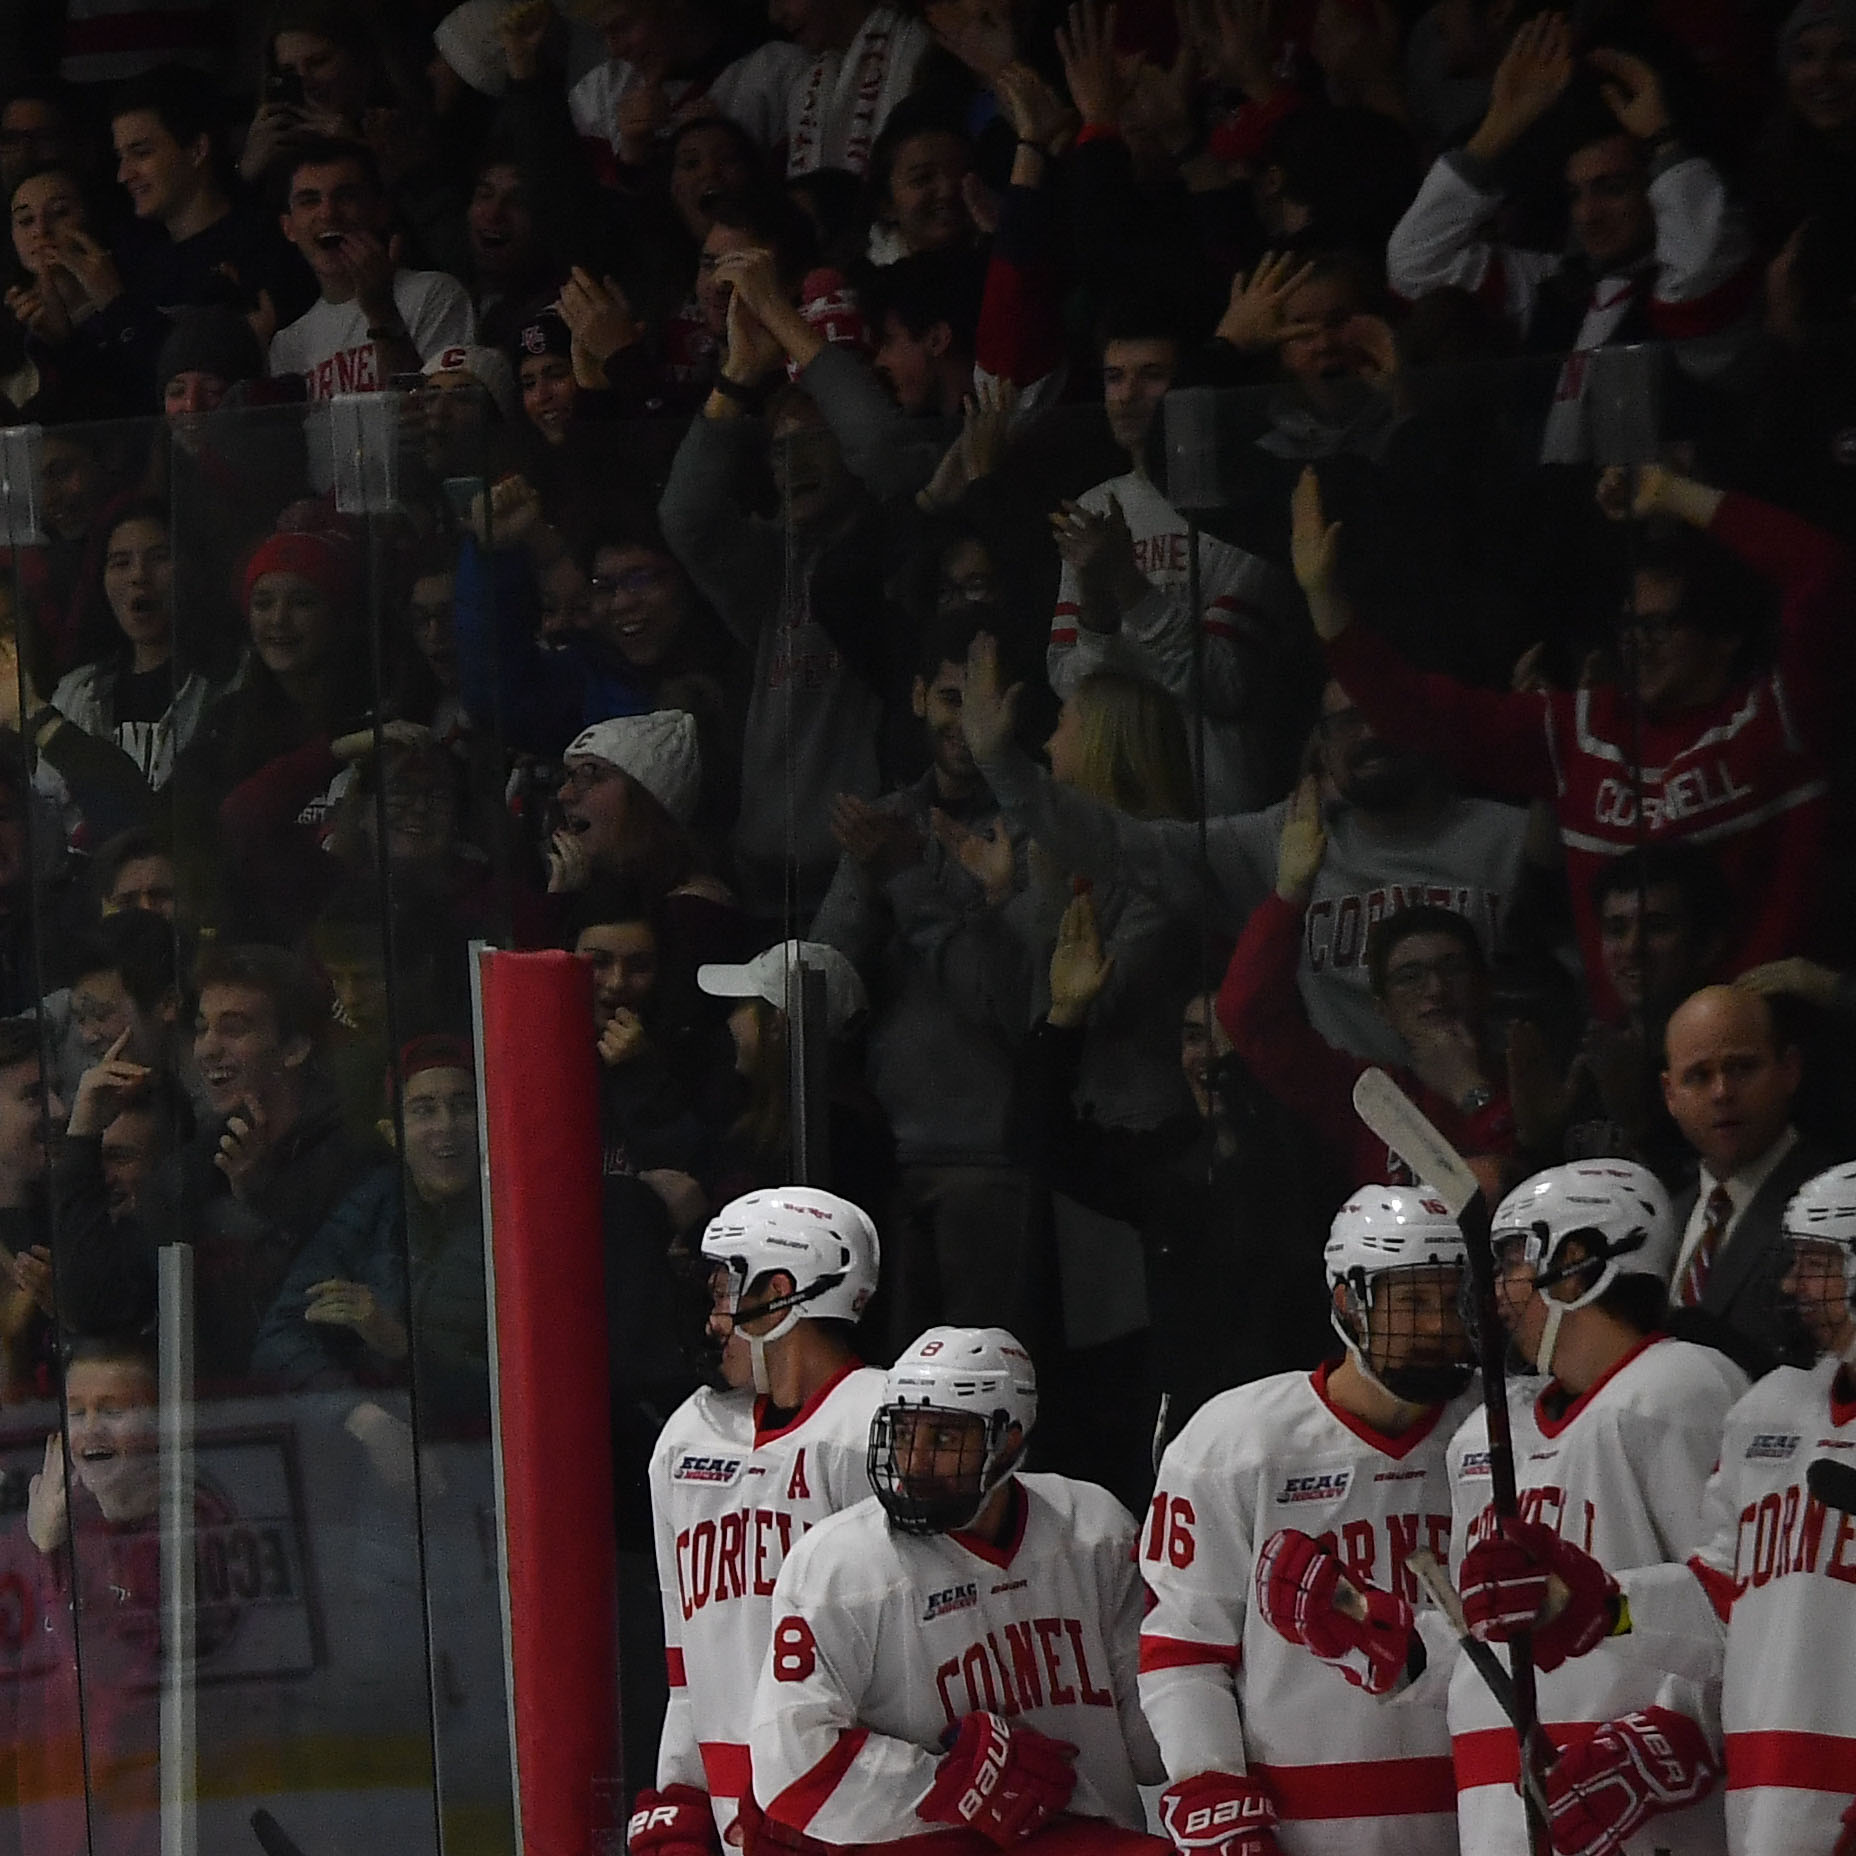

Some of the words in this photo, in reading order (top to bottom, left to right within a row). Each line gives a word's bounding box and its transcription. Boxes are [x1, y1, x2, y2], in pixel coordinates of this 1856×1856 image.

[788, 1448, 810, 1500] A
[1286, 1473, 1349, 1492] ECAC
[1146, 1491, 1196, 1570] 16
[774, 1616, 816, 1682] 8
